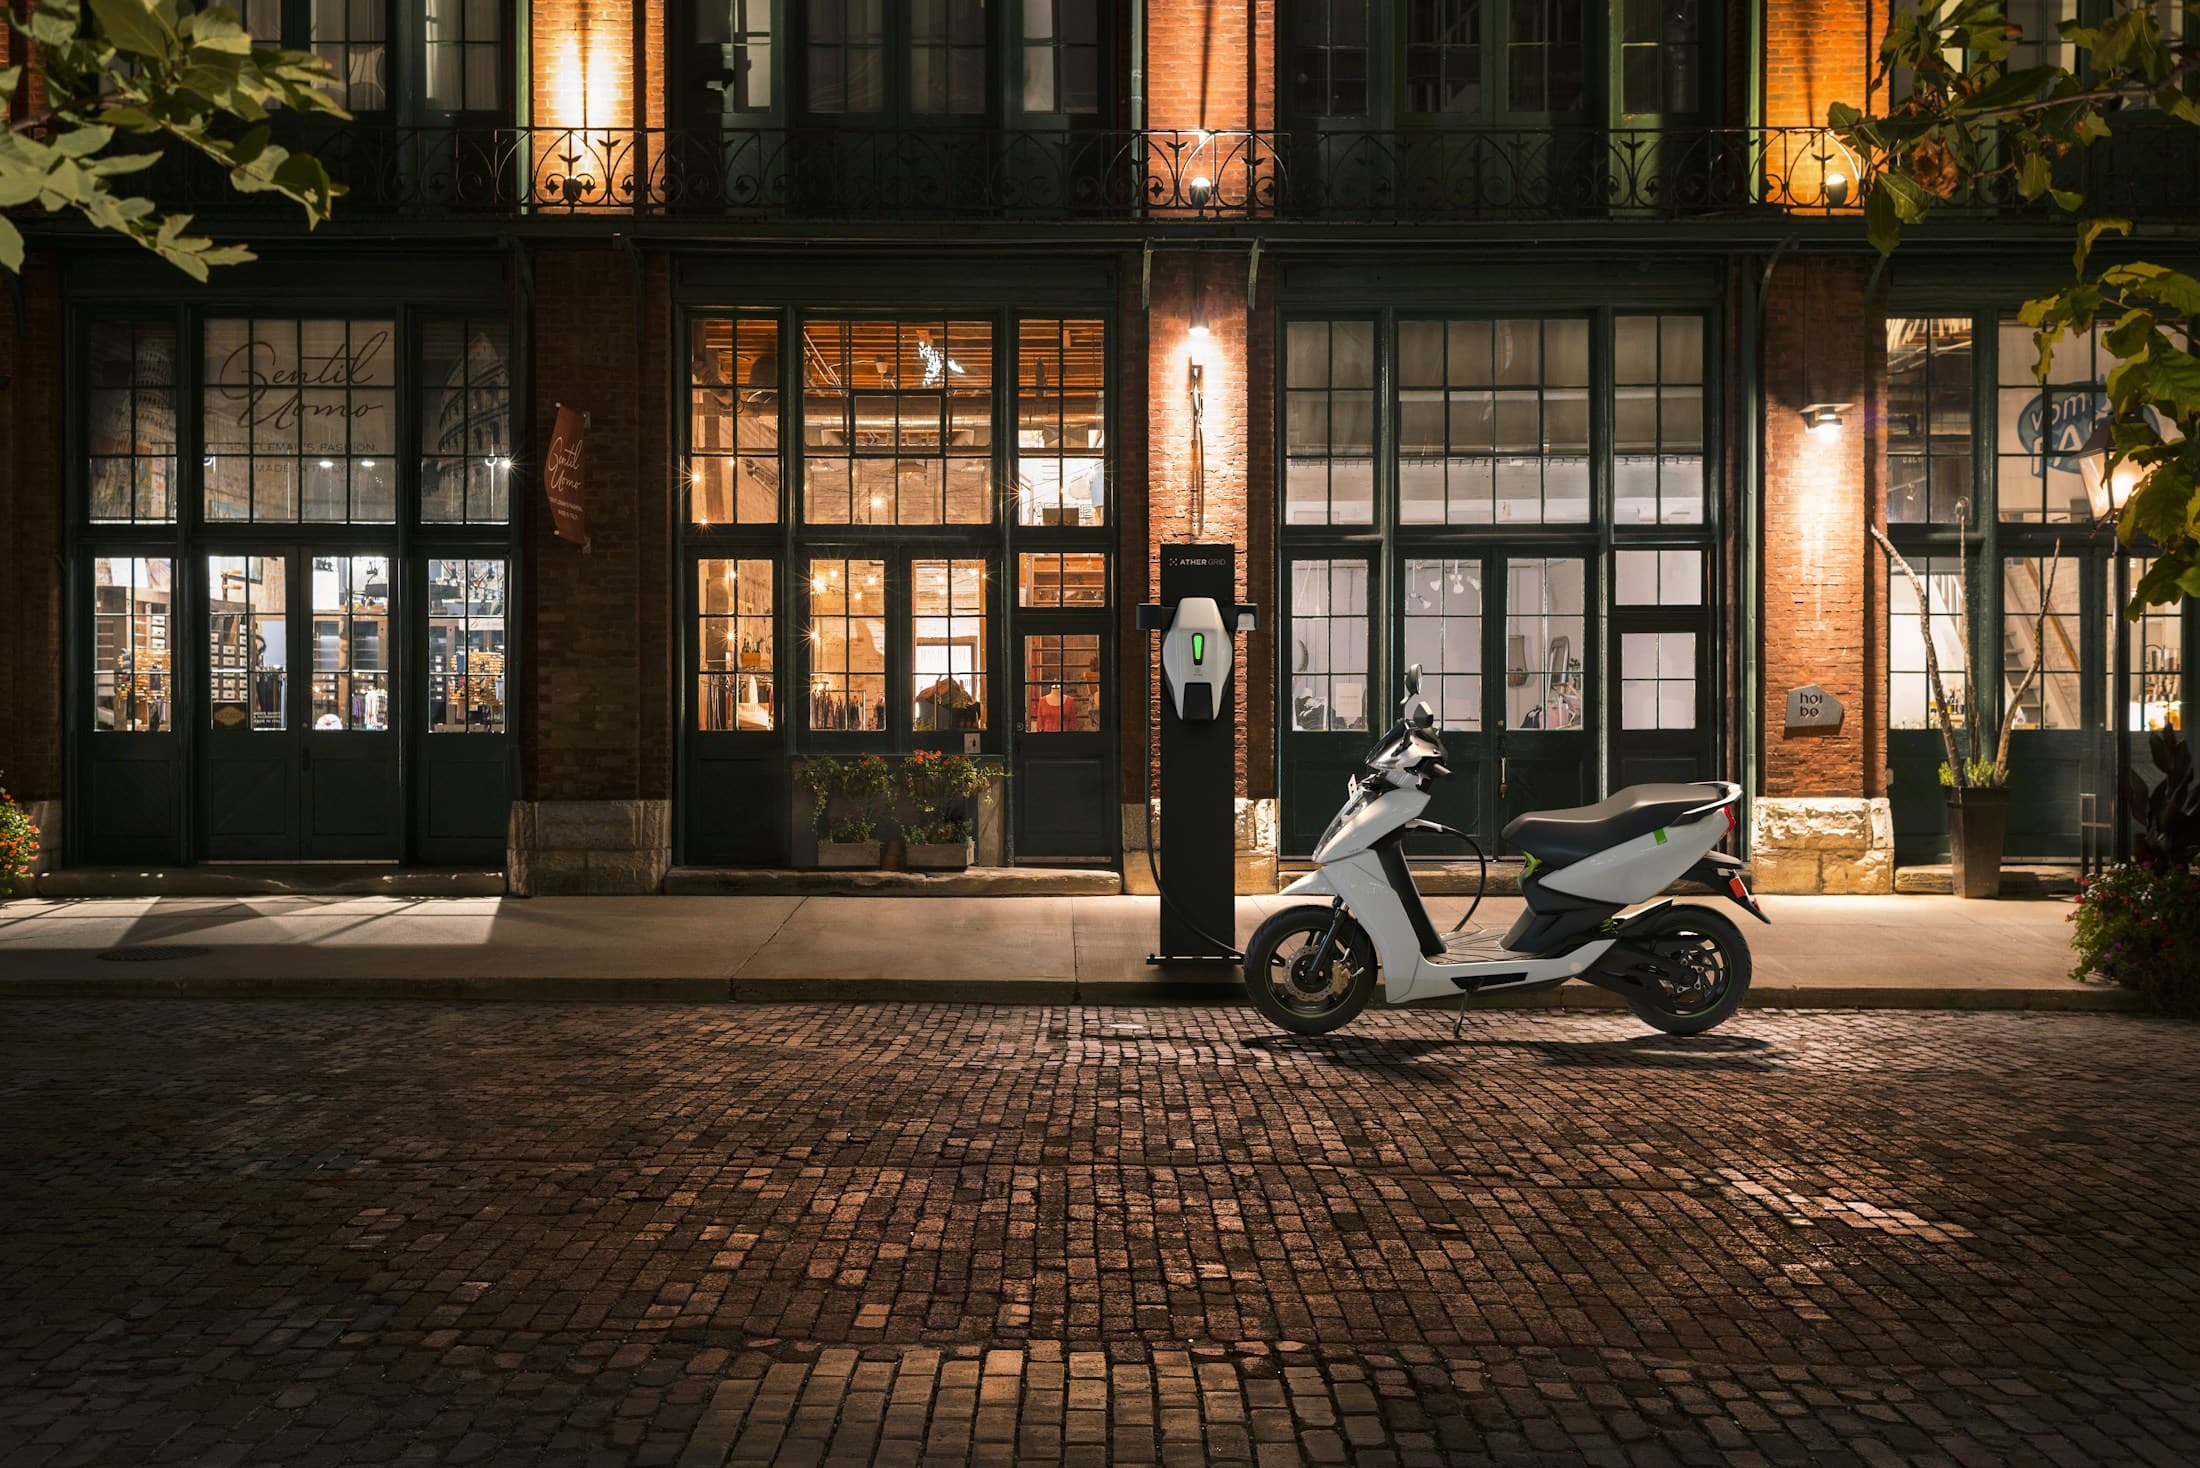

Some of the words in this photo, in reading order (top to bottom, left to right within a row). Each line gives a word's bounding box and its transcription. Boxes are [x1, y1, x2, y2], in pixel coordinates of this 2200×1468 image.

[220, 331, 388, 400] Gentil
[237, 383, 385, 430] Uomo
[548, 436, 583, 471] Gentil
[312, 463, 346, 473] ITLY
[551, 469, 581, 492] Uomo
[1180, 558, 1207, 566] ATHER
[1208, 558, 1226, 566] GRID
[1800, 706, 1819, 718] bo
